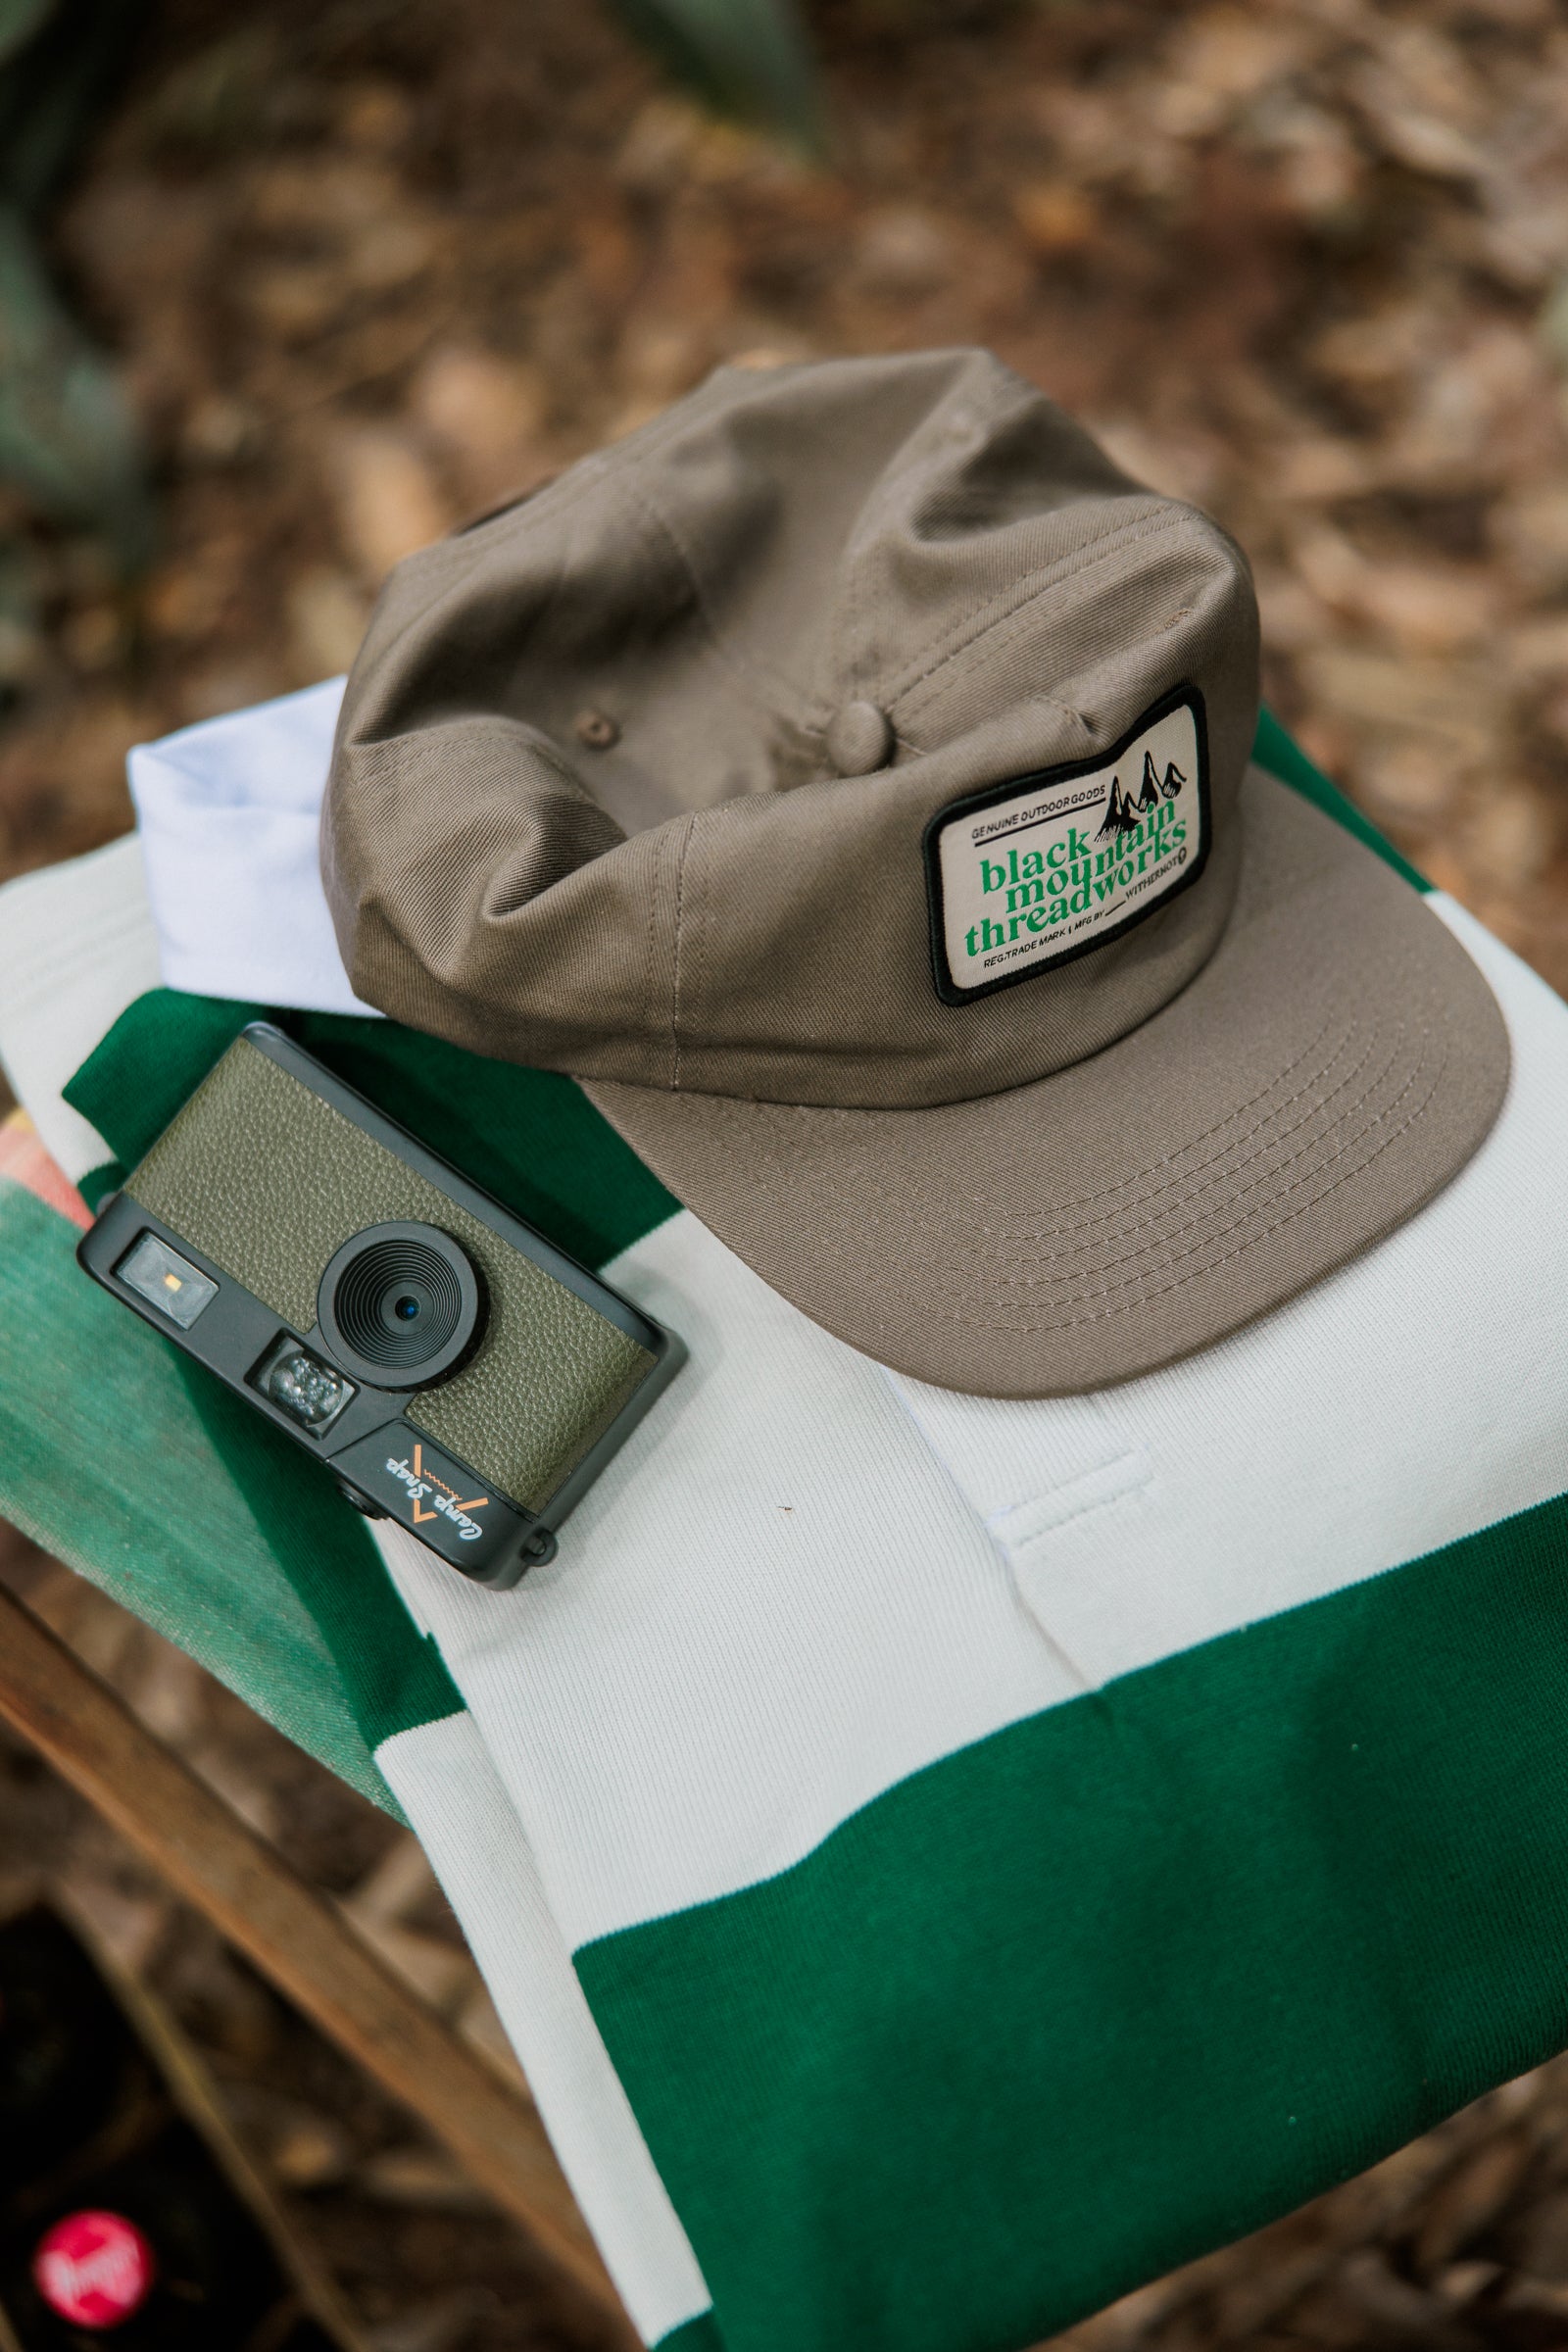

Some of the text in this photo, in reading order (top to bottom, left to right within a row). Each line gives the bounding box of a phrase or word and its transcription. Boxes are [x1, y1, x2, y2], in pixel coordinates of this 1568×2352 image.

[971, 784, 1105, 839] GENUINE OUTDOOR GOODS
[964, 819, 1187, 957] threadworks
[980, 827, 1092, 893] black
[1005, 800, 1176, 914] mountain
[1039, 928, 1066, 946] MARK
[1074, 916, 1093, 931] MFG
[1094, 909, 1105, 921] BY
[386, 1457, 483, 1540] Camp Snap
